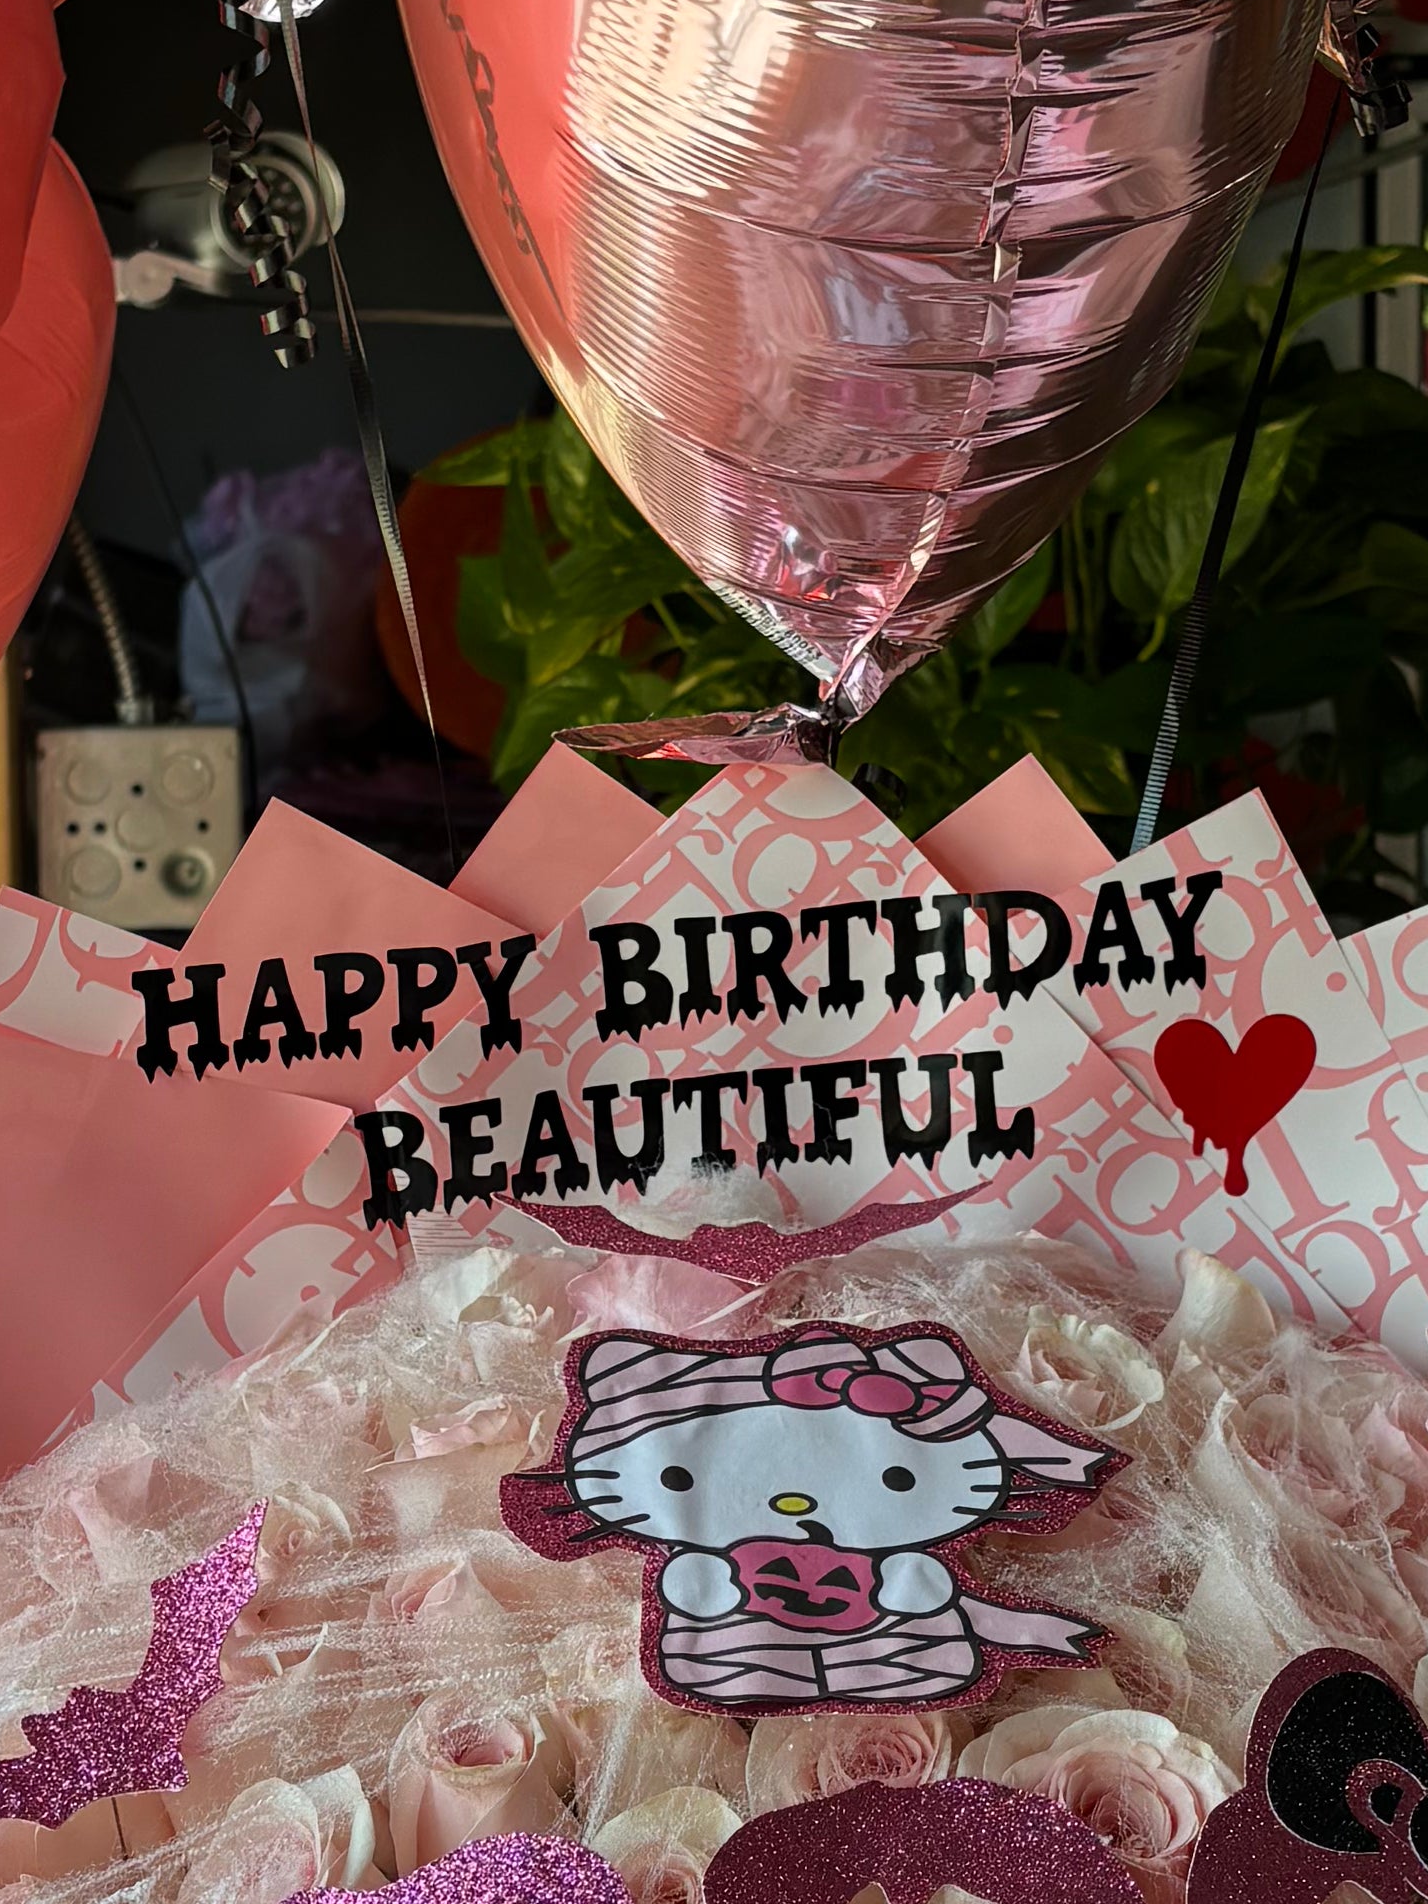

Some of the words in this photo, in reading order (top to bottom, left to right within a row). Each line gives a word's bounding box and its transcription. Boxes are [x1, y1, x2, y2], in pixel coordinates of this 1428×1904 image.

[132, 933, 536, 1084] HAPPY
[589, 869, 1224, 1045] BIRTHDAY
[354, 1050, 1035, 1232] BEAUTIFUL
